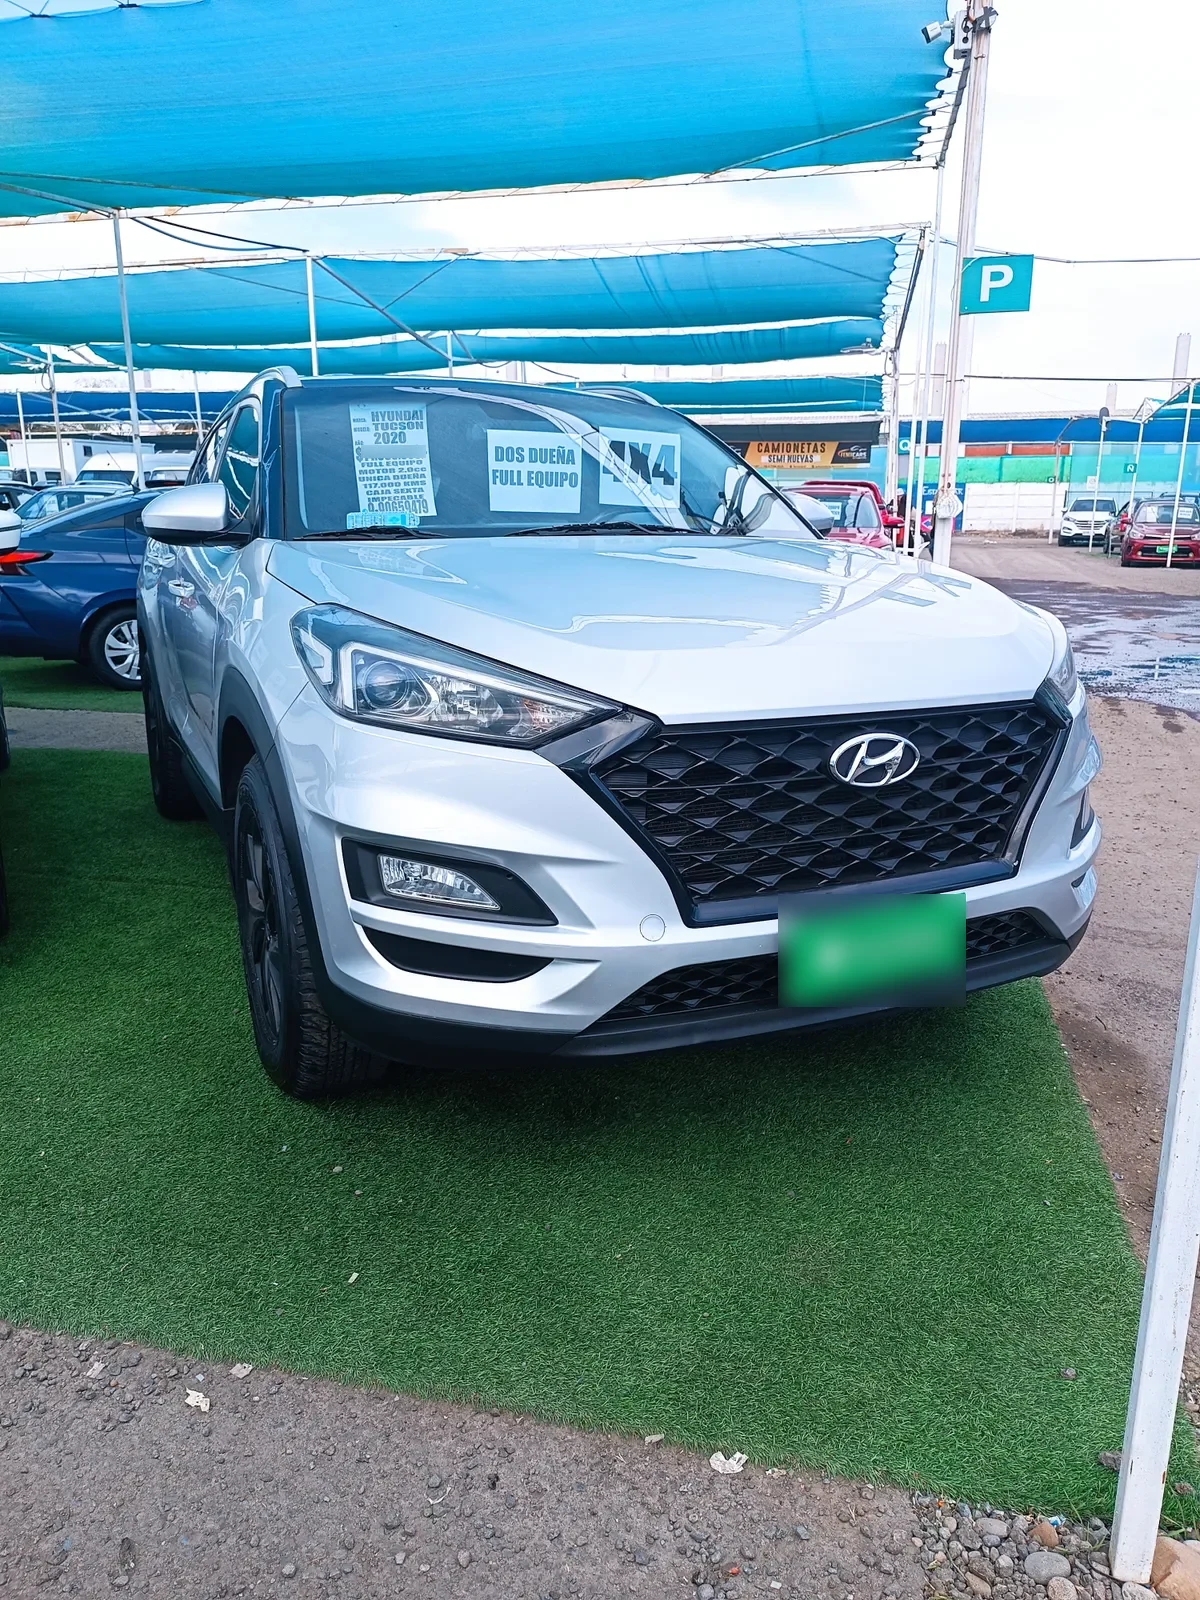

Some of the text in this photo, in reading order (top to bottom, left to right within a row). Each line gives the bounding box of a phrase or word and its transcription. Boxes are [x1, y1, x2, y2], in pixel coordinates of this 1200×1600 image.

[980, 264, 1014, 302] P
[371, 410, 424, 422] HYUNDAI
[372, 421, 424, 431] TUCSON
[373, 431, 407, 445] 2020
[757, 442, 826, 454] CAMIONETAS
[494, 445, 576, 465] DOS DUEÑA
[768, 454, 814, 463] SEMI NUEVAS
[602, 440, 678, 486] 4X4
[358, 467, 395, 475] MOTOR
[492, 469, 579, 488] FULL EQUIPO
